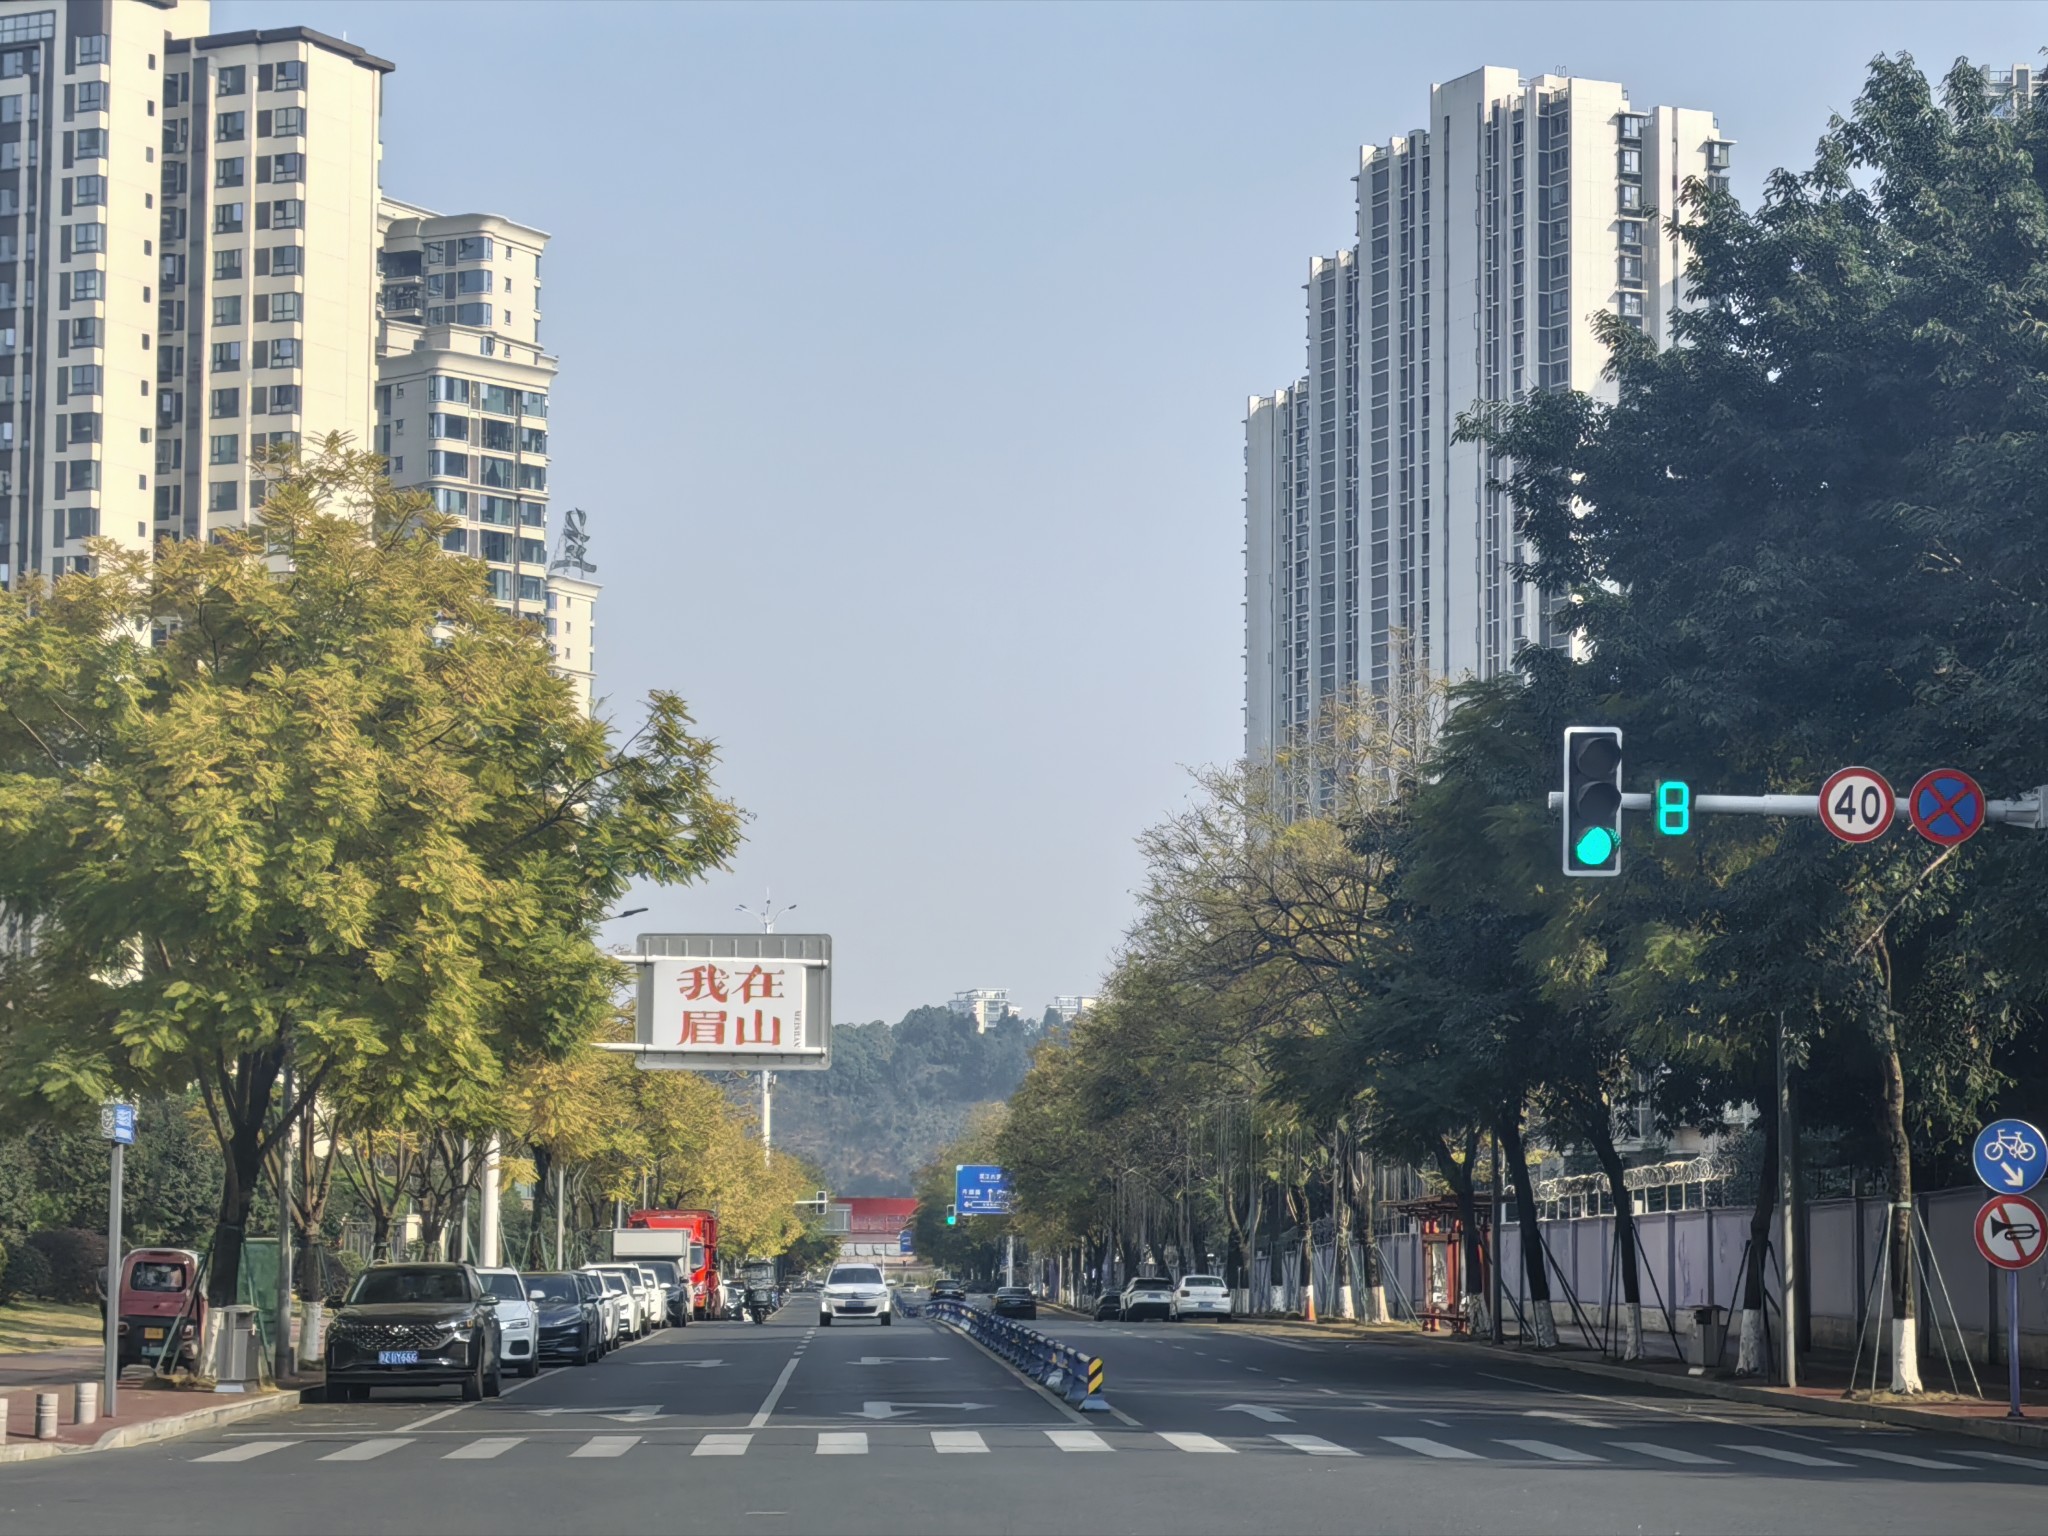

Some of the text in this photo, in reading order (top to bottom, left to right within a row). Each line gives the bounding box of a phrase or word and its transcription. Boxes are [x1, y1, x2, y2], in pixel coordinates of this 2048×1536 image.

[1659, 781, 1689, 835] 8
[1834, 785, 1881, 825] 40
[676, 963, 785, 1004] 我在
[676, 1009, 781, 1046] 眉山
